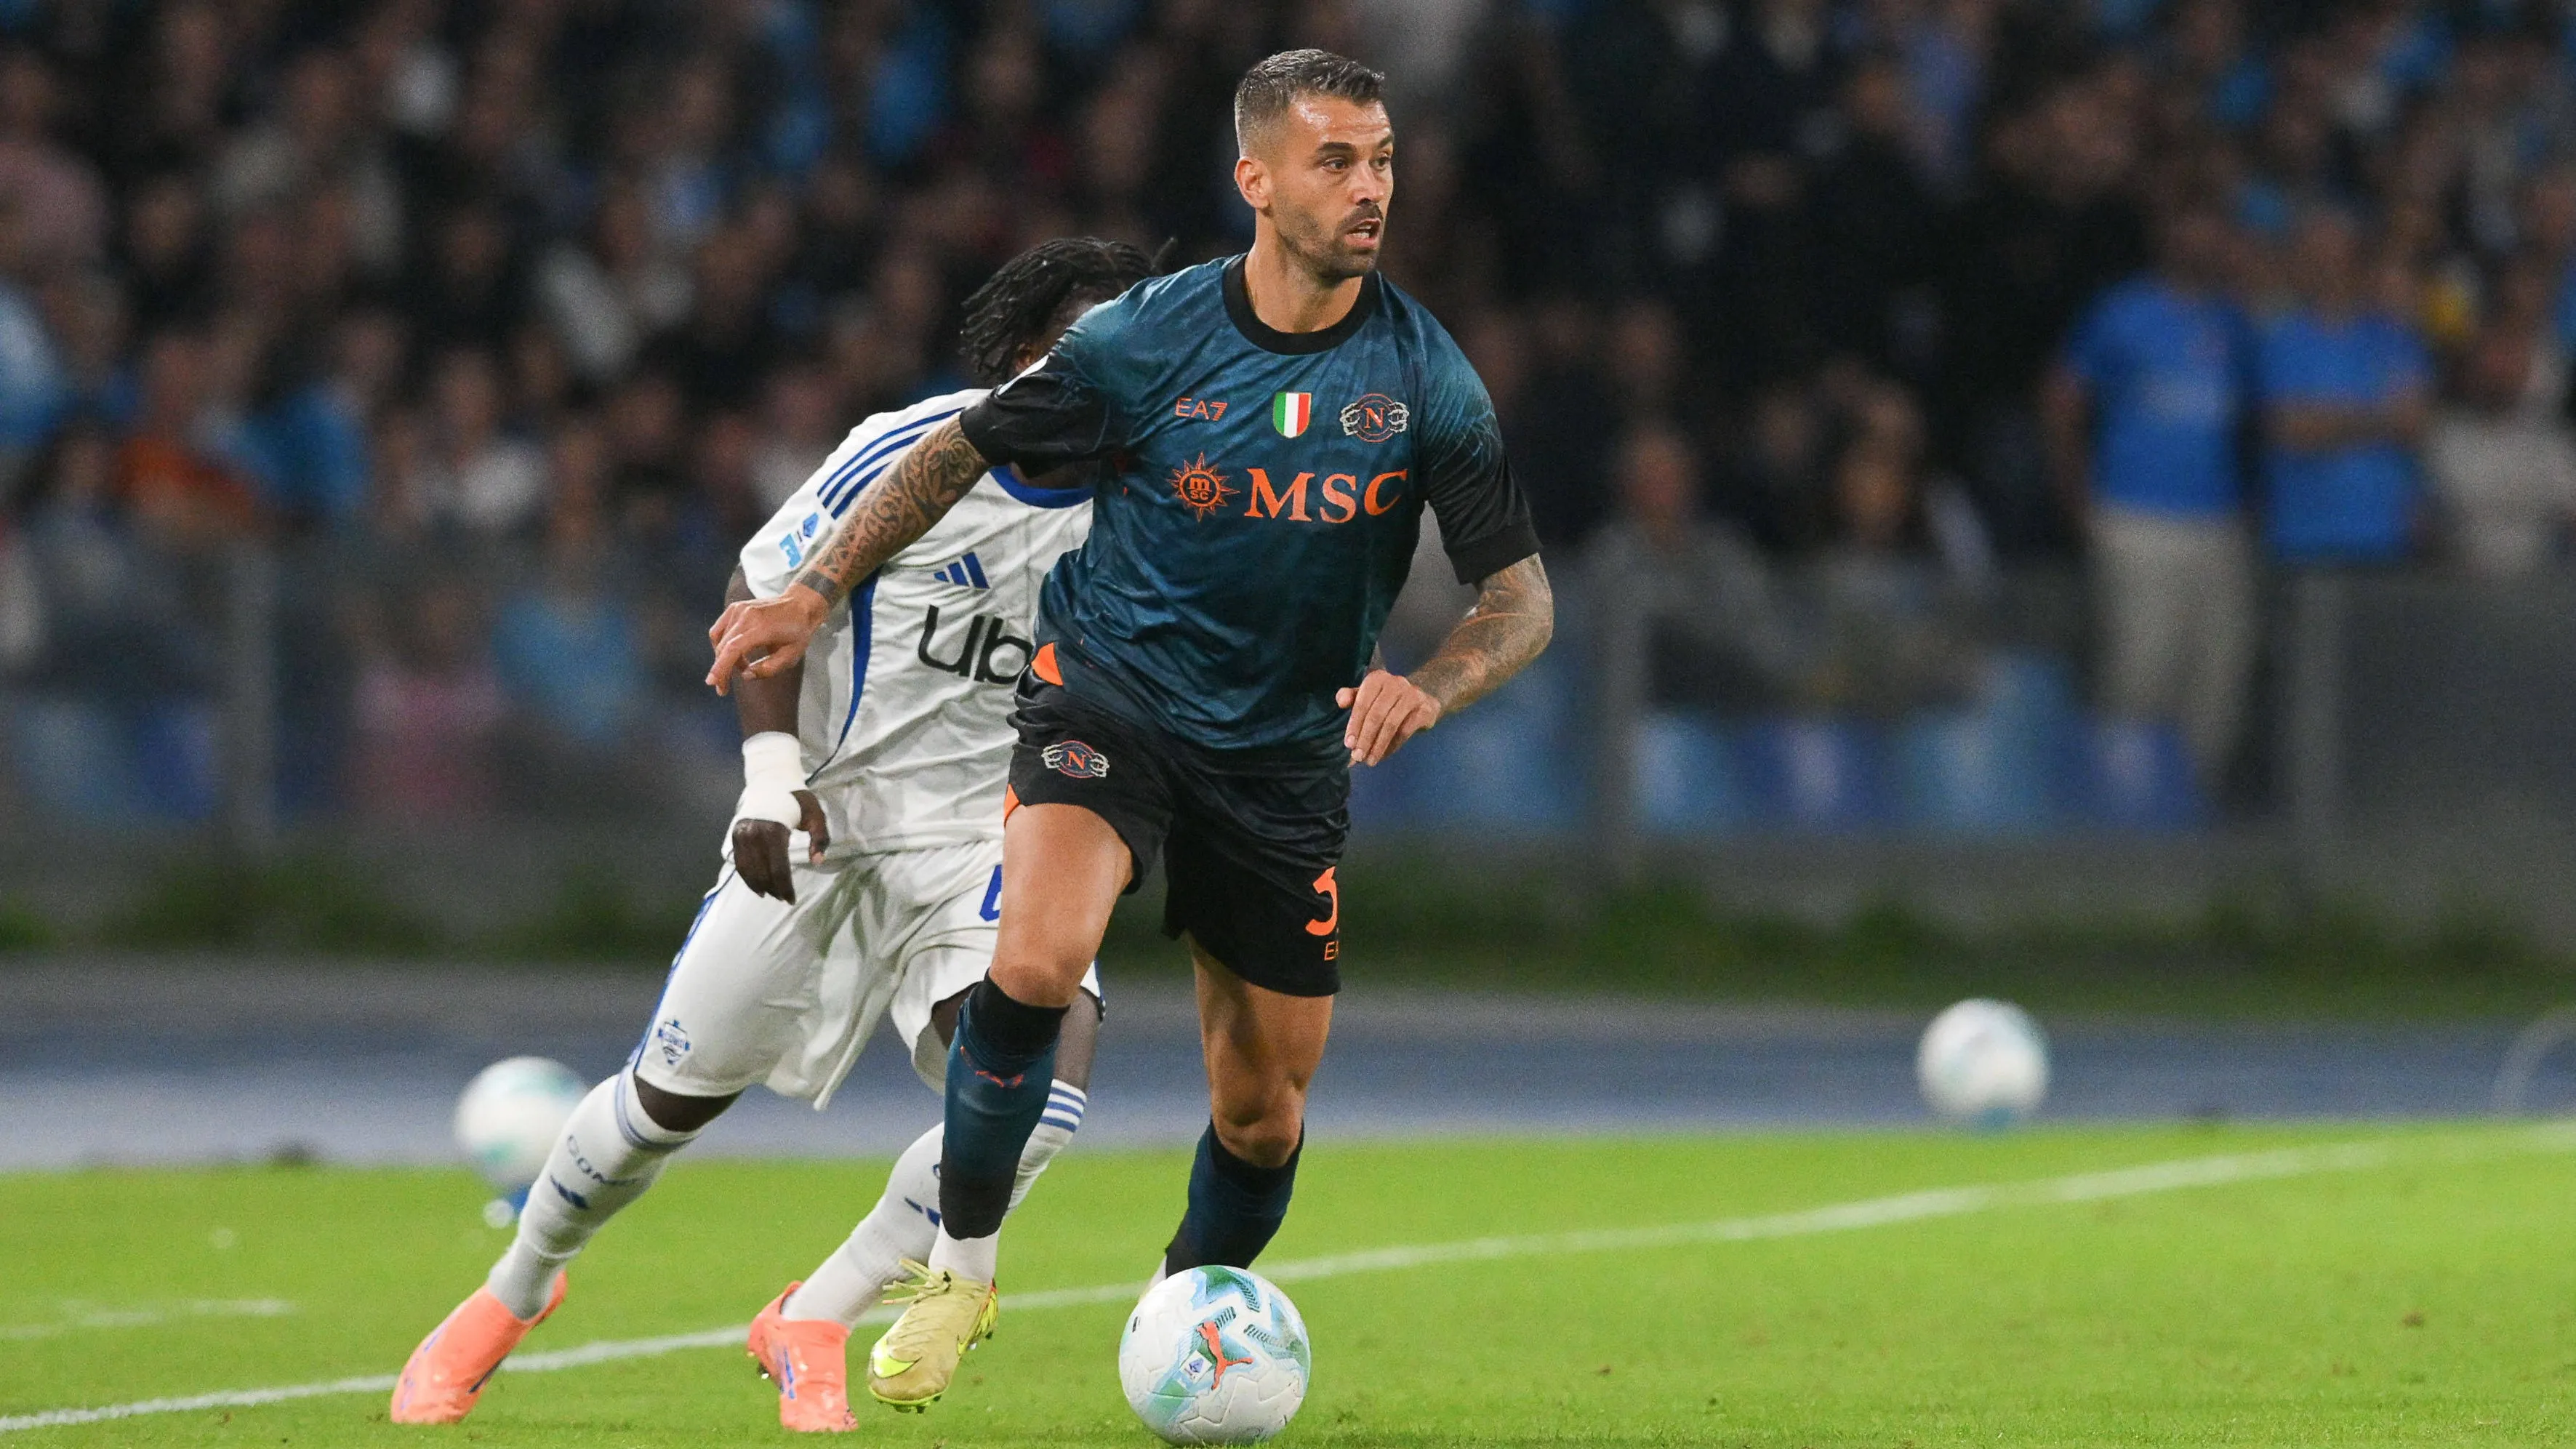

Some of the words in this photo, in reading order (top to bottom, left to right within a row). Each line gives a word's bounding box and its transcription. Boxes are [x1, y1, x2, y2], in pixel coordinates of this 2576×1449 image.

[1175, 397, 1228, 421] EA7
[1363, 407, 1384, 428] N
[1243, 467, 1408, 523] MSC
[1067, 750, 1086, 770] N
[1324, 941, 1339, 960] E
